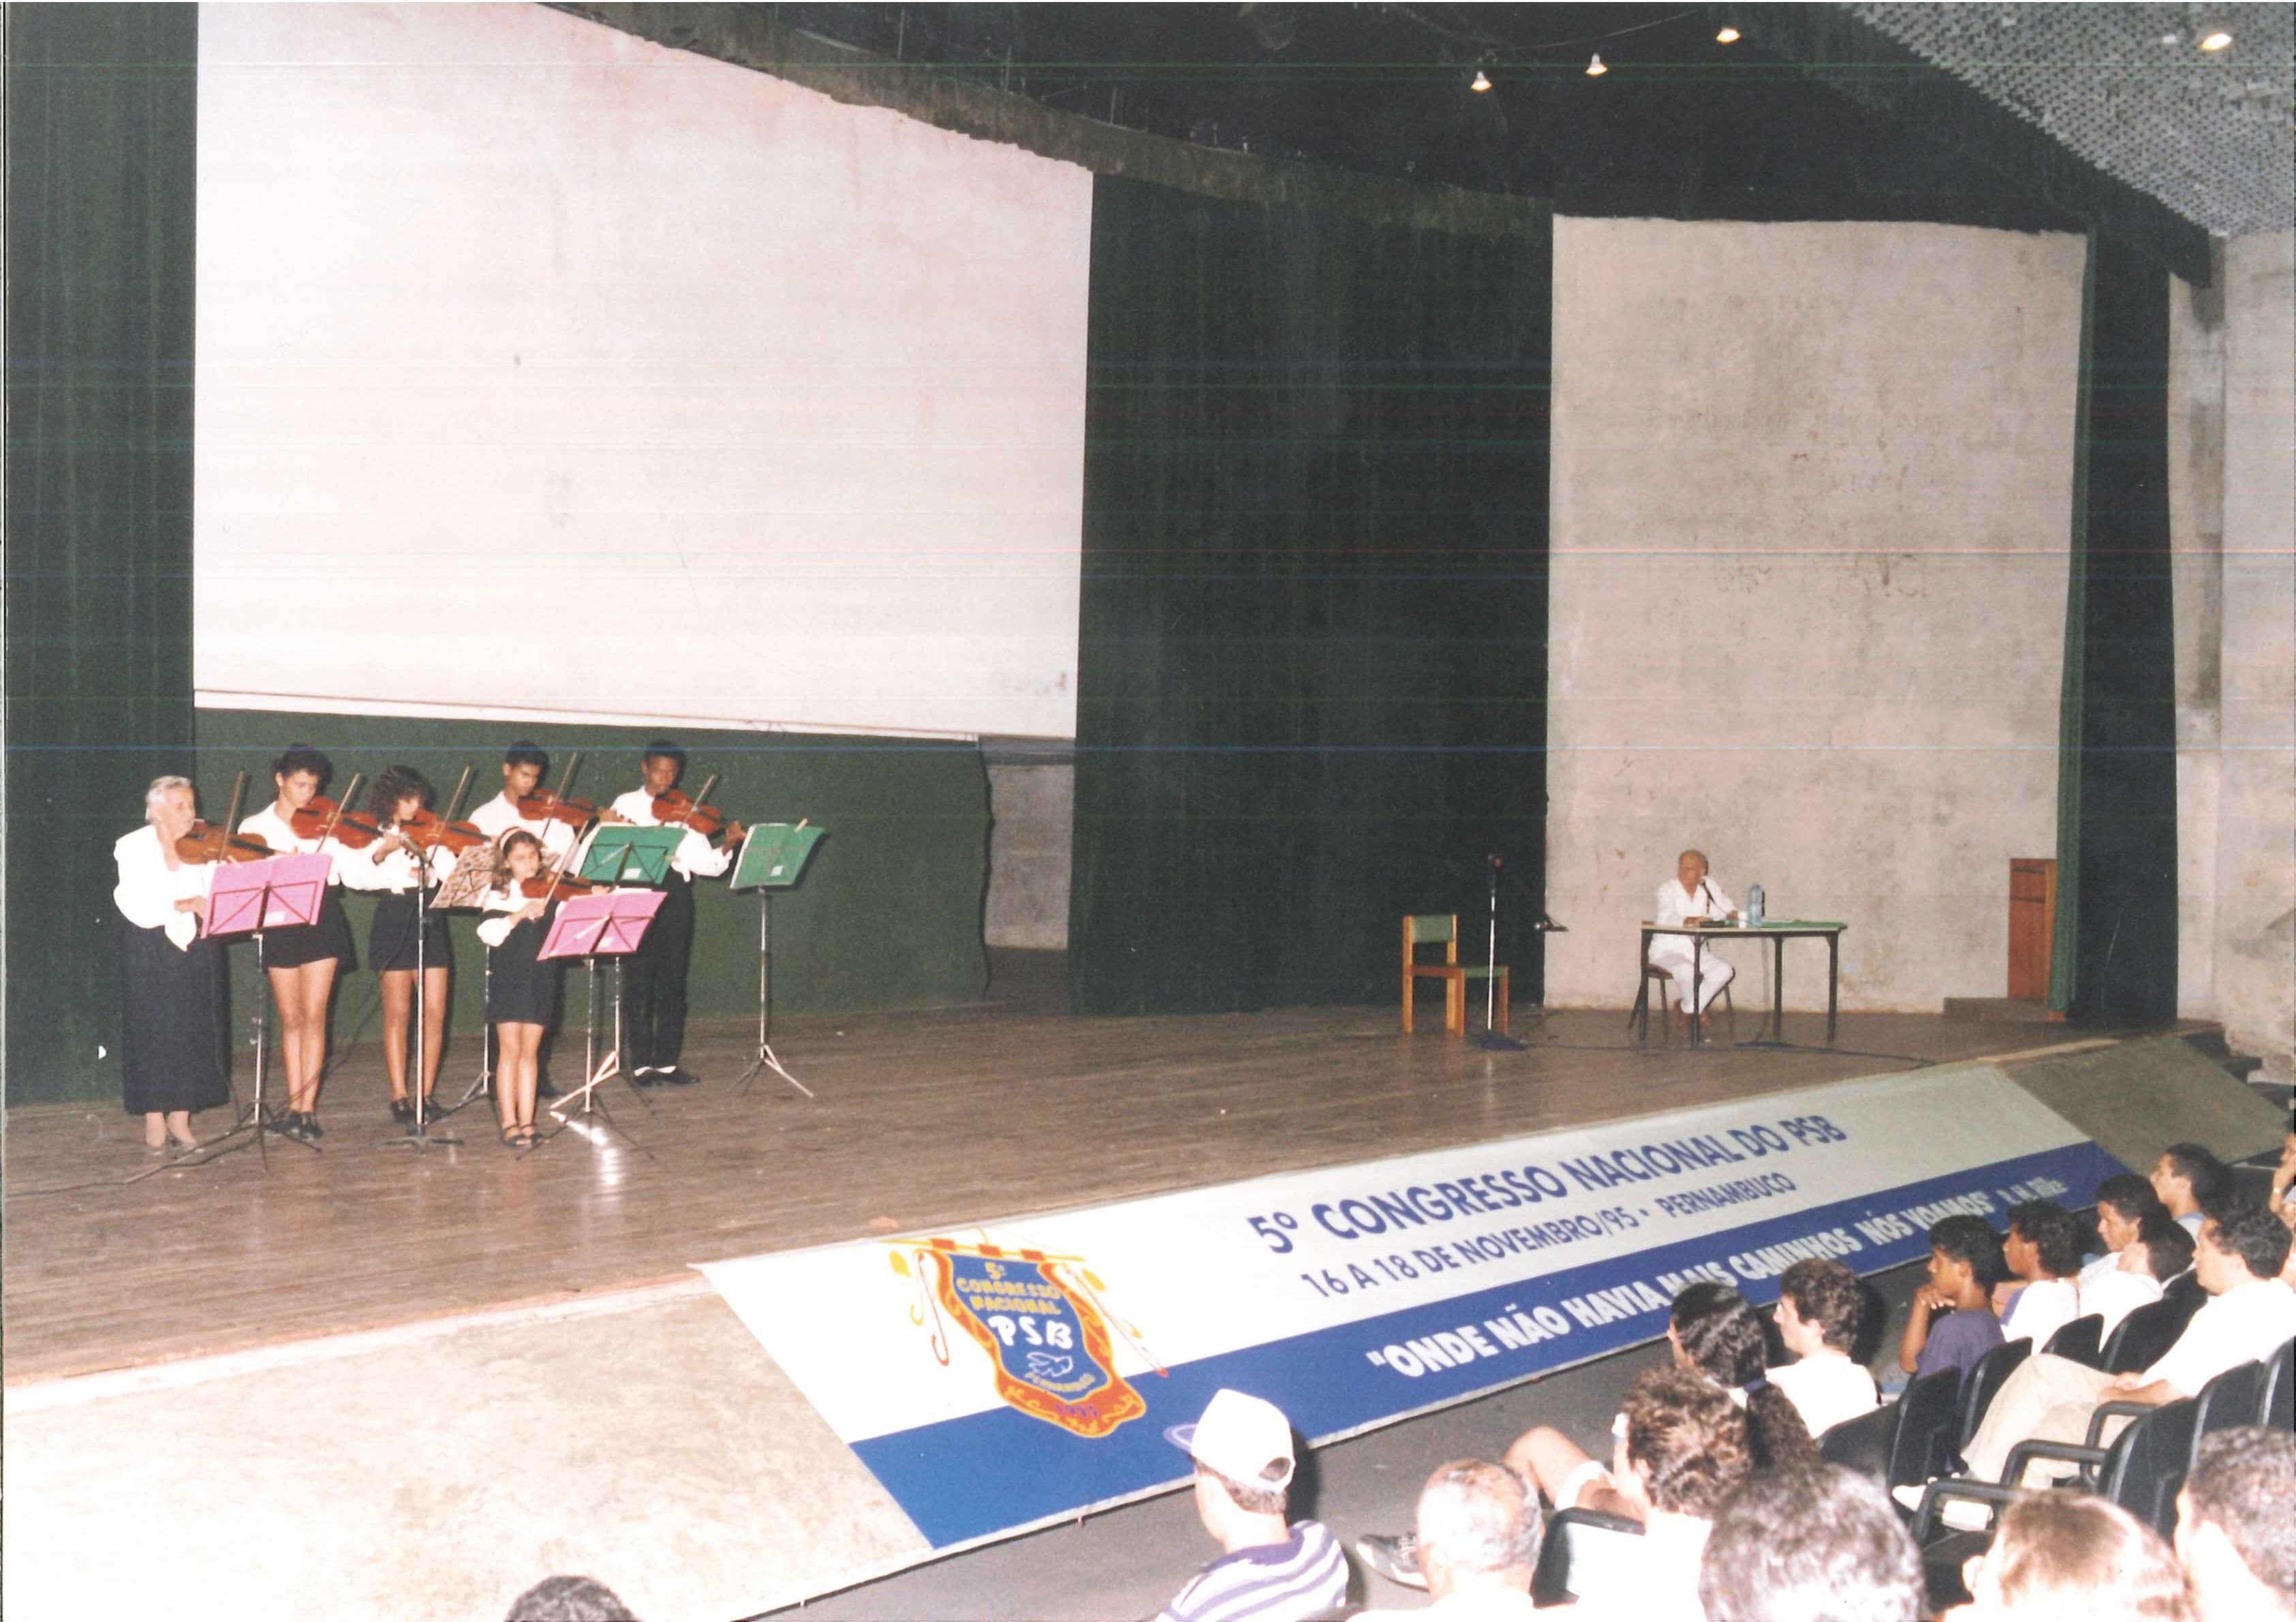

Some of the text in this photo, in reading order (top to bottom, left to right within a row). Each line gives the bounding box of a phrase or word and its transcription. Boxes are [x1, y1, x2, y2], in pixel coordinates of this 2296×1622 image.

[1301, 1269, 1350, 1297] 16
[1347, 1263, 1380, 1289] A
[1374, 1255, 1419, 1281] 18
[1412, 1246, 1461, 1273] DE
[1452, 1206, 1639, 1265] NOVEMBRO/95
[1654, 1172, 1797, 1218] PERNAMBUCO
[1312, 1166, 1568, 1239] CONGRESSO
[1557, 1135, 1746, 1191] NACIONAL
[1726, 1124, 1790, 1157] DO
[1778, 1115, 1847, 1146] PSB
[987, 1315, 1074, 1349] PSB
[1484, 1303, 1571, 1349] NÃO
[1560, 1281, 1673, 1328] HAVIA
[1656, 1261, 1738, 1296] MAIS
[1728, 1227, 1863, 1280] CAMINHOS
[1853, 1210, 1914, 1246] NÓS
